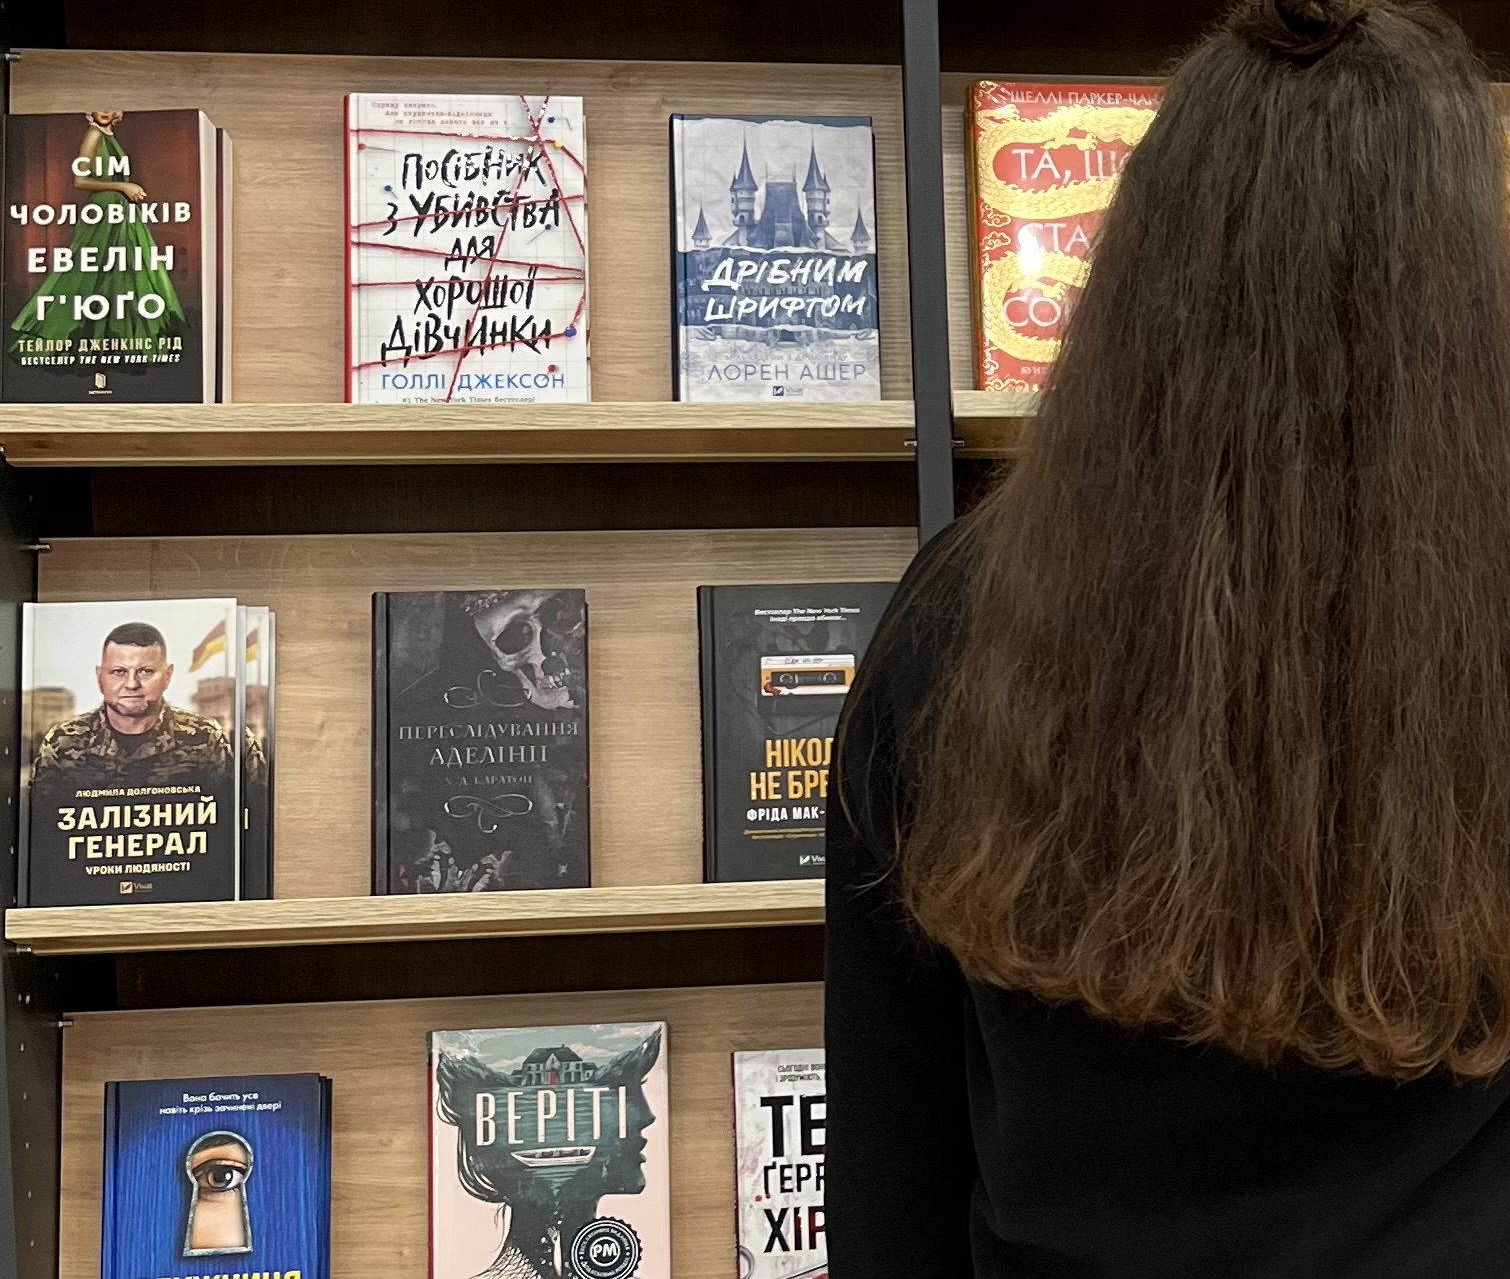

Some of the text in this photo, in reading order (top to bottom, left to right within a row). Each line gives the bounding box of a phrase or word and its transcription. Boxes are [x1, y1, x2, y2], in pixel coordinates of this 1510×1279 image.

[1010, 90, 1063, 105] ШЕЛЛІ
[72, 155, 131, 177] СІМ
[402, 145, 548, 191] ПОСІБНИК
[1011, 148, 1071, 184] ТА,
[10, 202, 191, 226] ЧОЛОВІКІВ
[409, 188, 560, 237] УБИВСТВА
[27, 245, 175, 273] ЕВЕЛІН
[444, 235, 495, 272] ДЛЯ
[702, 257, 867, 292] ДРІБНИМ
[414, 266, 538, 319] ХОРОШОЇ
[704, 295, 866, 322] ШРИФТОМ
[18, 336, 183, 353] ТЕЙЛОР ДЖЕНКІНС РІД
[380, 312, 552, 368] ДІВЧИНКИ
[79, 355, 97, 365] THE
[101, 355, 121, 364] NEW
[124, 354, 148, 364] YORK
[152, 353, 180, 364] TIMES
[707, 363, 866, 381] ЛОРЕН АШЕР
[382, 373, 564, 391] ГОЛЛІ ДЖЕКСОН
[399, 722, 579, 741] ПЕРЕСЛІДУВАННЯ
[765, 738, 834, 768] НІКОЛ
[75, 787, 125, 798] ЛЮДМИЛА
[749, 771, 782, 800] НЕ
[57, 796, 217, 831] ЗАЛІЗНИЙ
[746, 807, 788, 821] ФРІДА
[68, 832, 208, 860] ГЕНЕРАЛ
[85, 862, 191, 875] УРОКИ ЛЮДЯНОСТІ
[160, 1105, 188, 1115] навіть
[189, 1104, 213, 1115] крізь
[257, 1101, 282, 1113] двері
[183, 1091, 259, 1103] Вона бачить усе
[476, 1086, 627, 1147] ВЕРІТІ
[760, 1095, 826, 1157] ТЕ
